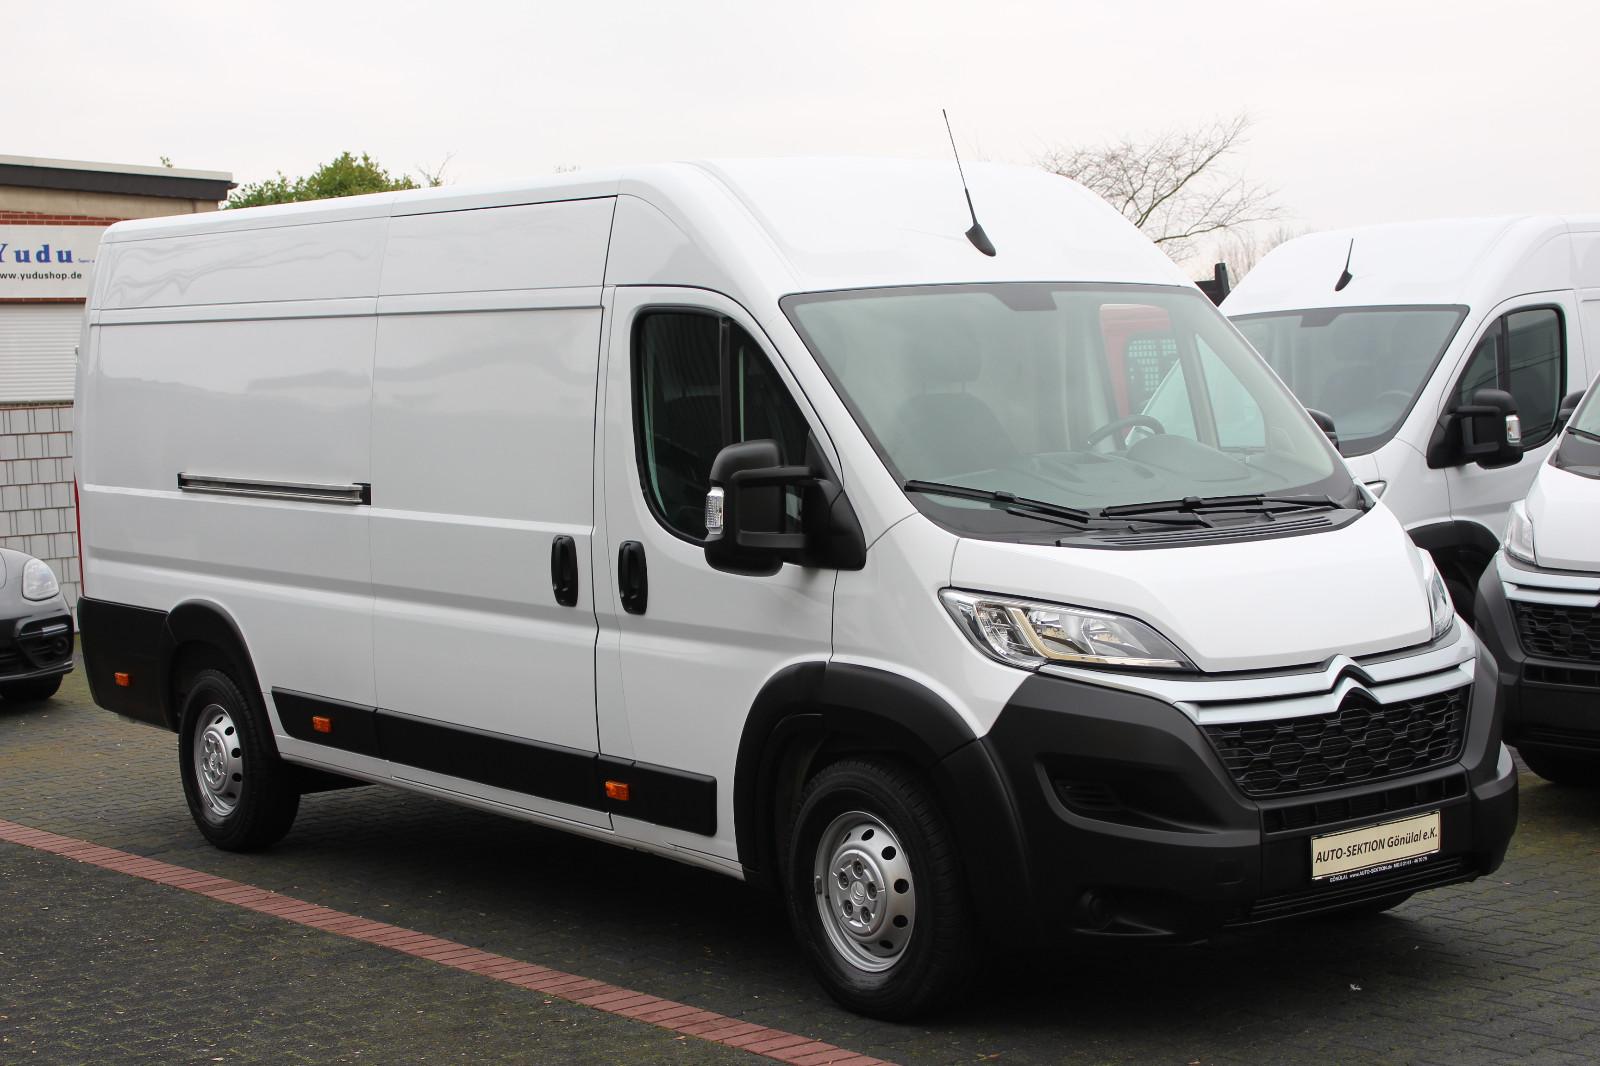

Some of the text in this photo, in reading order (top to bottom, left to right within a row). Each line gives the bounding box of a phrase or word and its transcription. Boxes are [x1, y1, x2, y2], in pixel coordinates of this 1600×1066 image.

[1315, 838, 1386, 863] AUTO-SEKTION
[1387, 830, 1422, 848] Gönülal
[1423, 827, 1438, 841] e.K.
